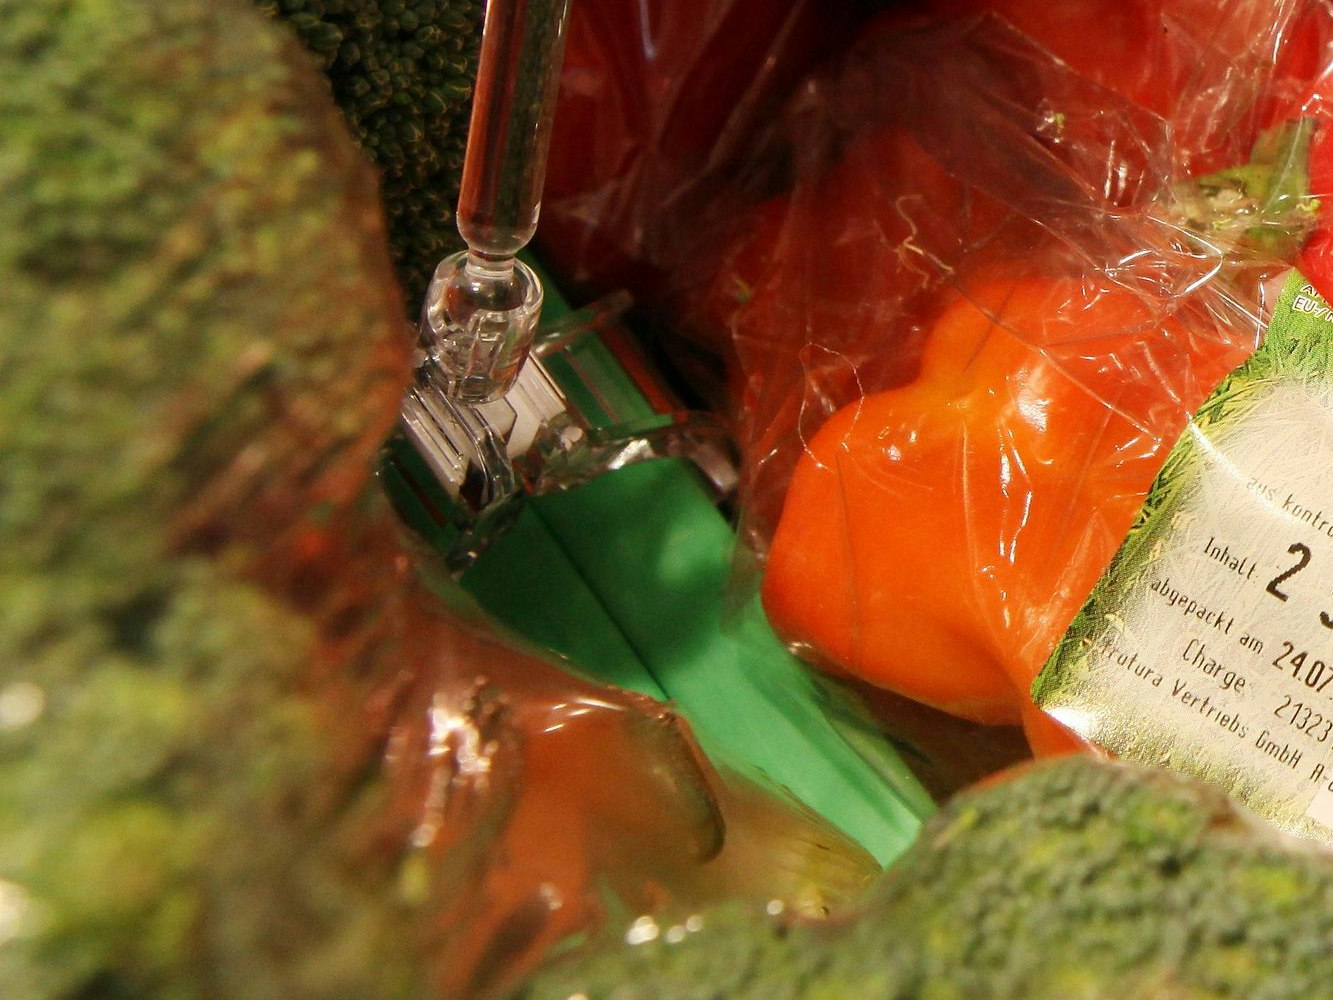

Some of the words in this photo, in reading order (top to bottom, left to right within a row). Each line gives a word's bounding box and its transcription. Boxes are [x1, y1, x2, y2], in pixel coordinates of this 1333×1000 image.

[1265, 541, 1313, 603] 2
[1150, 578, 1236, 636] abgepackt
[1170, 677, 1250, 740] Vertriebs
[1254, 728, 1304, 770] GmbH
